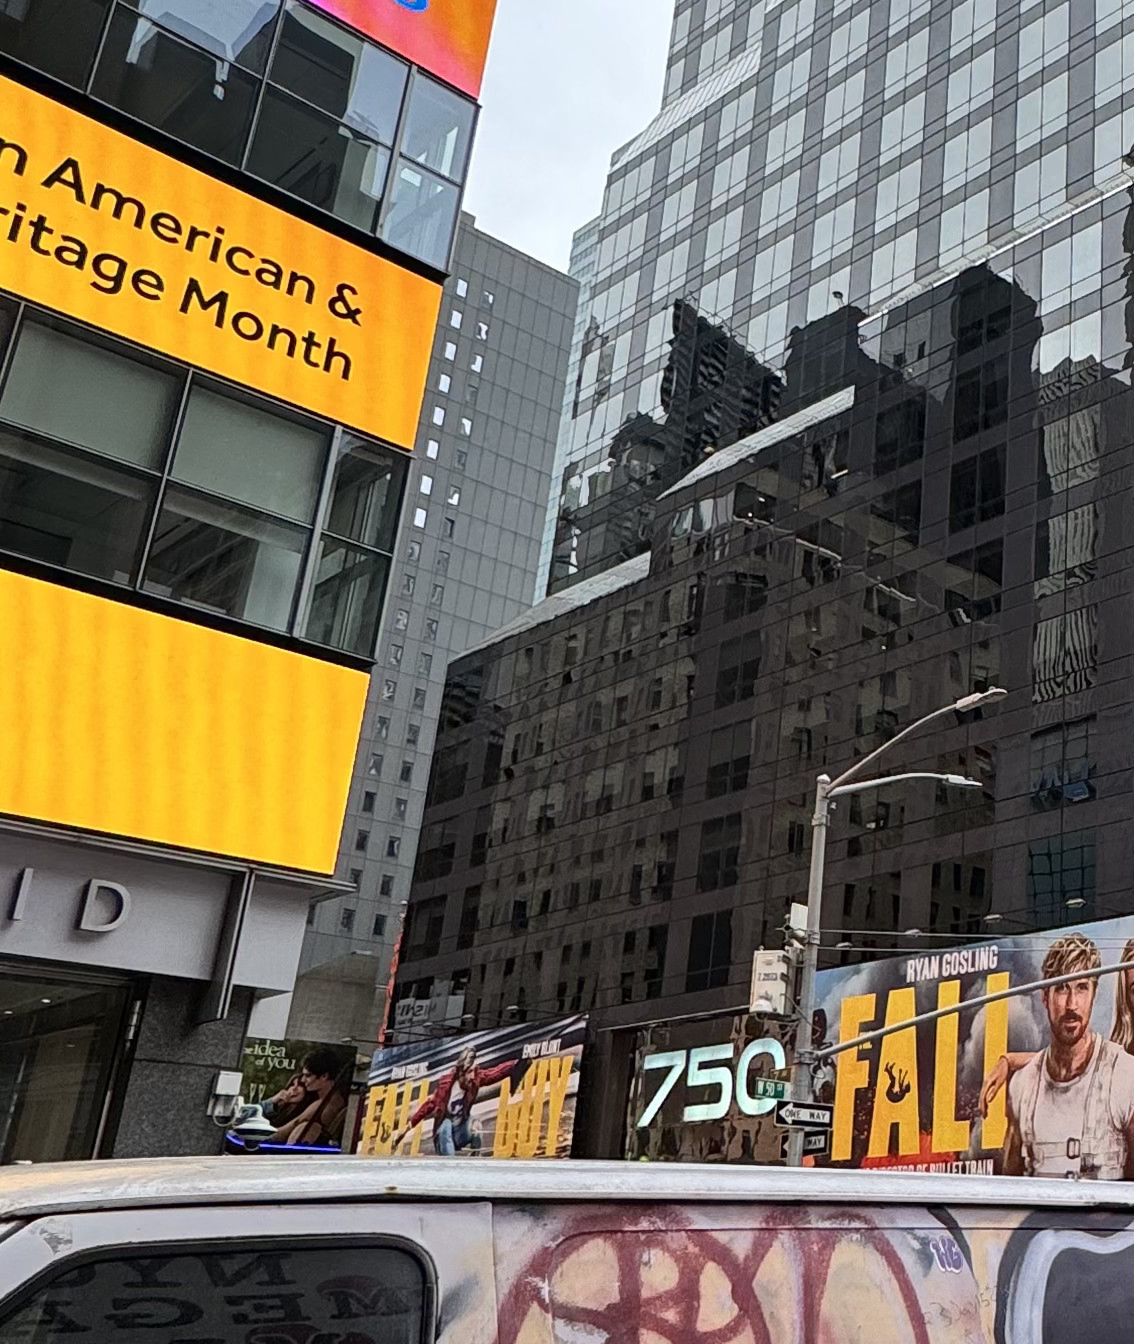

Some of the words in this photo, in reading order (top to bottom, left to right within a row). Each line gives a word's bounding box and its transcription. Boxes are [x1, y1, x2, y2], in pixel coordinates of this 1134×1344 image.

[41, 157, 316, 304] American
[328, 284, 362, 327] &
[179, 277, 352, 381] Month
[906, 955, 940, 983] RYAN
[941, 945, 999, 978] GOSLING
[254, 1040, 286, 1058] idea
[268, 1057, 296, 1072] you
[637, 1037, 786, 1128] 750
[784, 1108, 802, 1119] ONE
[809, 1110, 827, 1121] WAY
[965, 1158, 994, 1175] TRAIN
